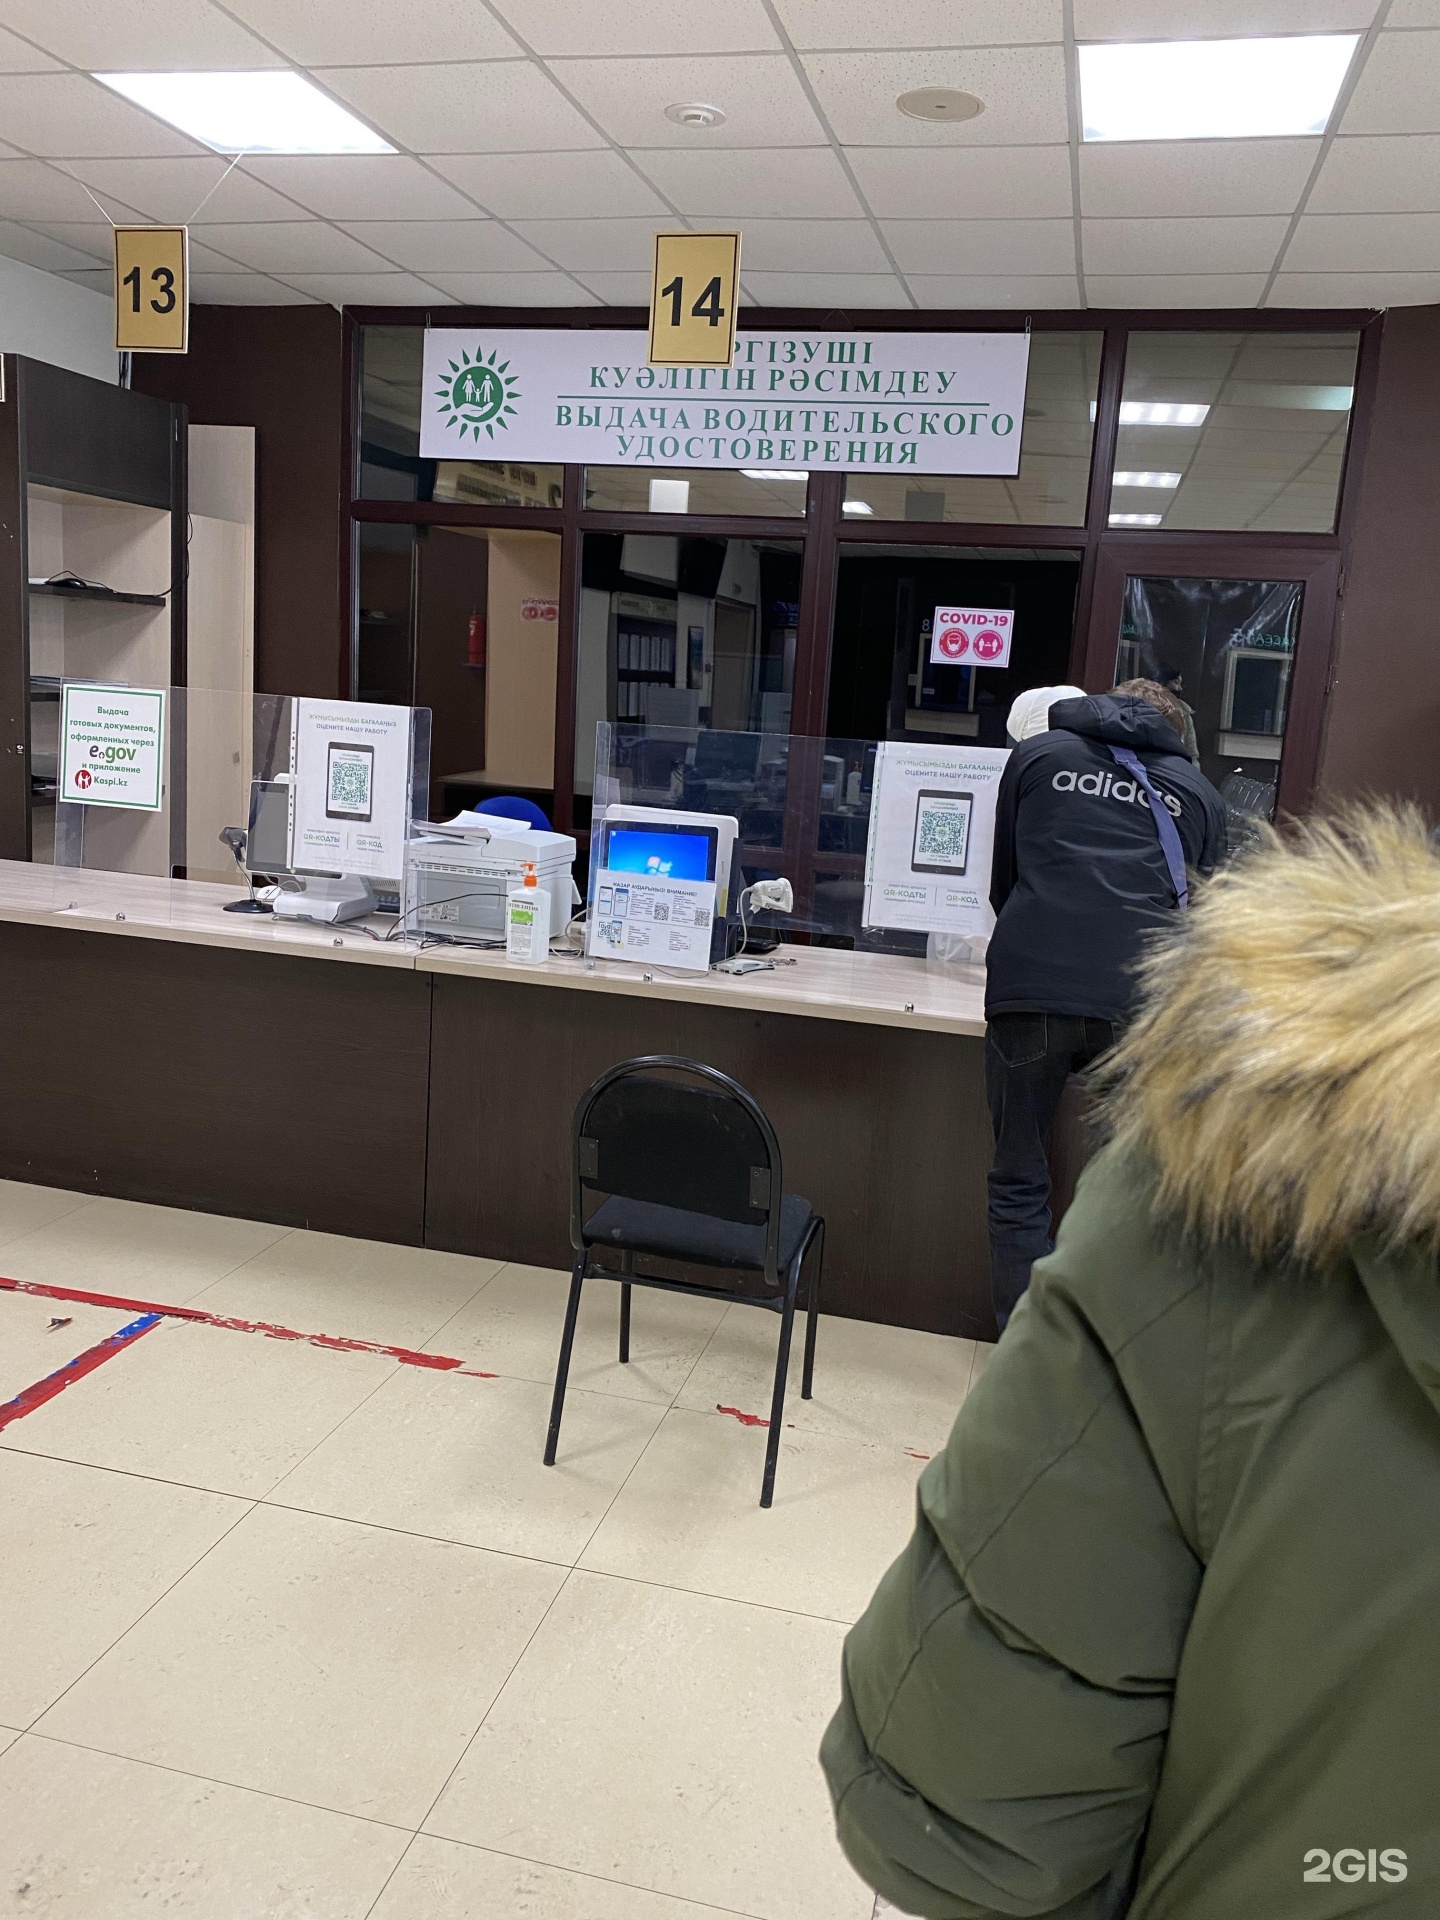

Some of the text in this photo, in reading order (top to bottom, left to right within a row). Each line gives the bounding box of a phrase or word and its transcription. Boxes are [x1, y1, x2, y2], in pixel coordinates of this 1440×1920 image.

[122, 265, 176, 314] 13
[661, 275, 726, 327] 14
[589, 366, 958, 399] КУӘЛІГІН РӘСІМДЕУ
[555, 405, 1014, 436] ВЫДАЧА ВОДИТЕЛЬСКОГО
[616, 434, 919, 464] УДОСТОВЕРЕНИЯ
[939, 612, 1009, 627] COVID-19
[97, 706, 129, 716] Выдача
[69, 719, 156, 733] готовых документов,
[316, 723, 344, 731] ОЦЕНИТЕ
[70, 733, 155, 747] оформленных через
[88, 763, 141, 774] приложение
[93, 775, 128, 787] Kaspi.kz
[904, 769, 938, 778] ОЦЕНИТЕ
[962, 773, 991, 781] РАБОТУ
[303, 833, 340, 843] QR-КОДТЫ
[356, 839, 383, 849] QR-КОД
[883, 888, 927, 899] QR-КОДТЫ
[946, 894, 979, 905] QR-КОД
